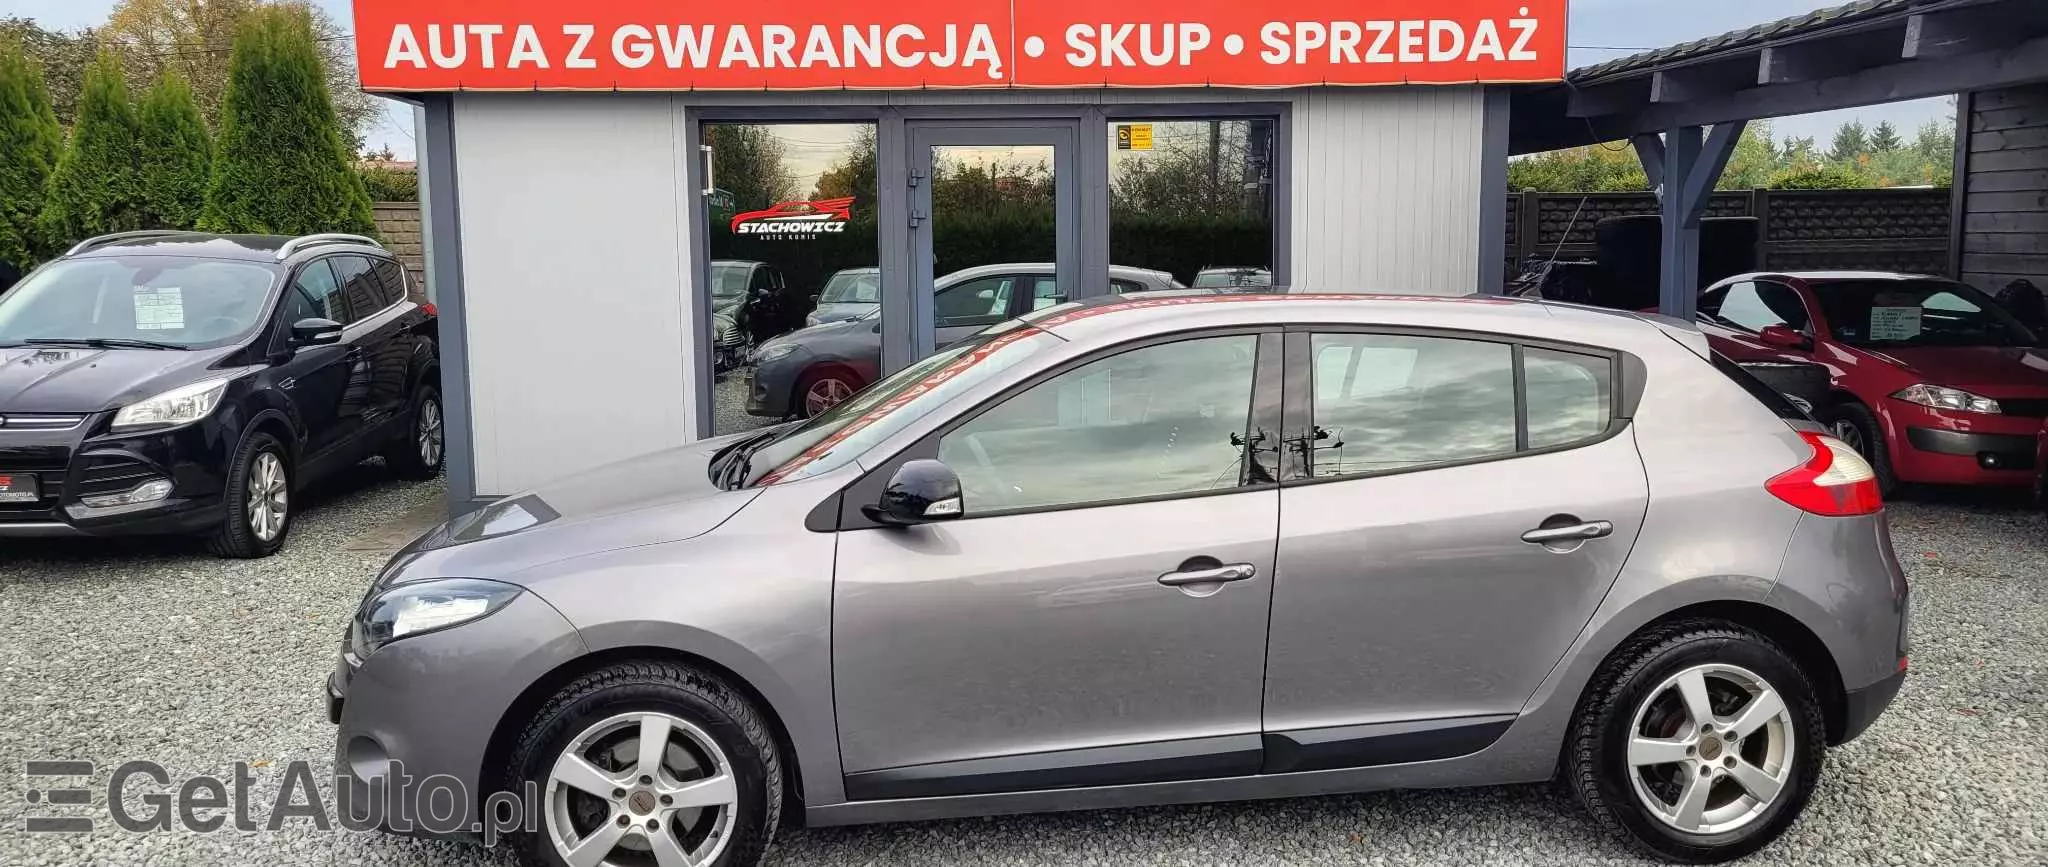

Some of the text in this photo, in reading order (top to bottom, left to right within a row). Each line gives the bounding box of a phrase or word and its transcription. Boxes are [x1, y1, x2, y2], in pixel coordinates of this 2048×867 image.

[383, 6, 1538, 80] AUTA Z GWARANCJĄ SKUP SPRZEDAŻ
[737, 221, 846, 234] STACHOWICZ
